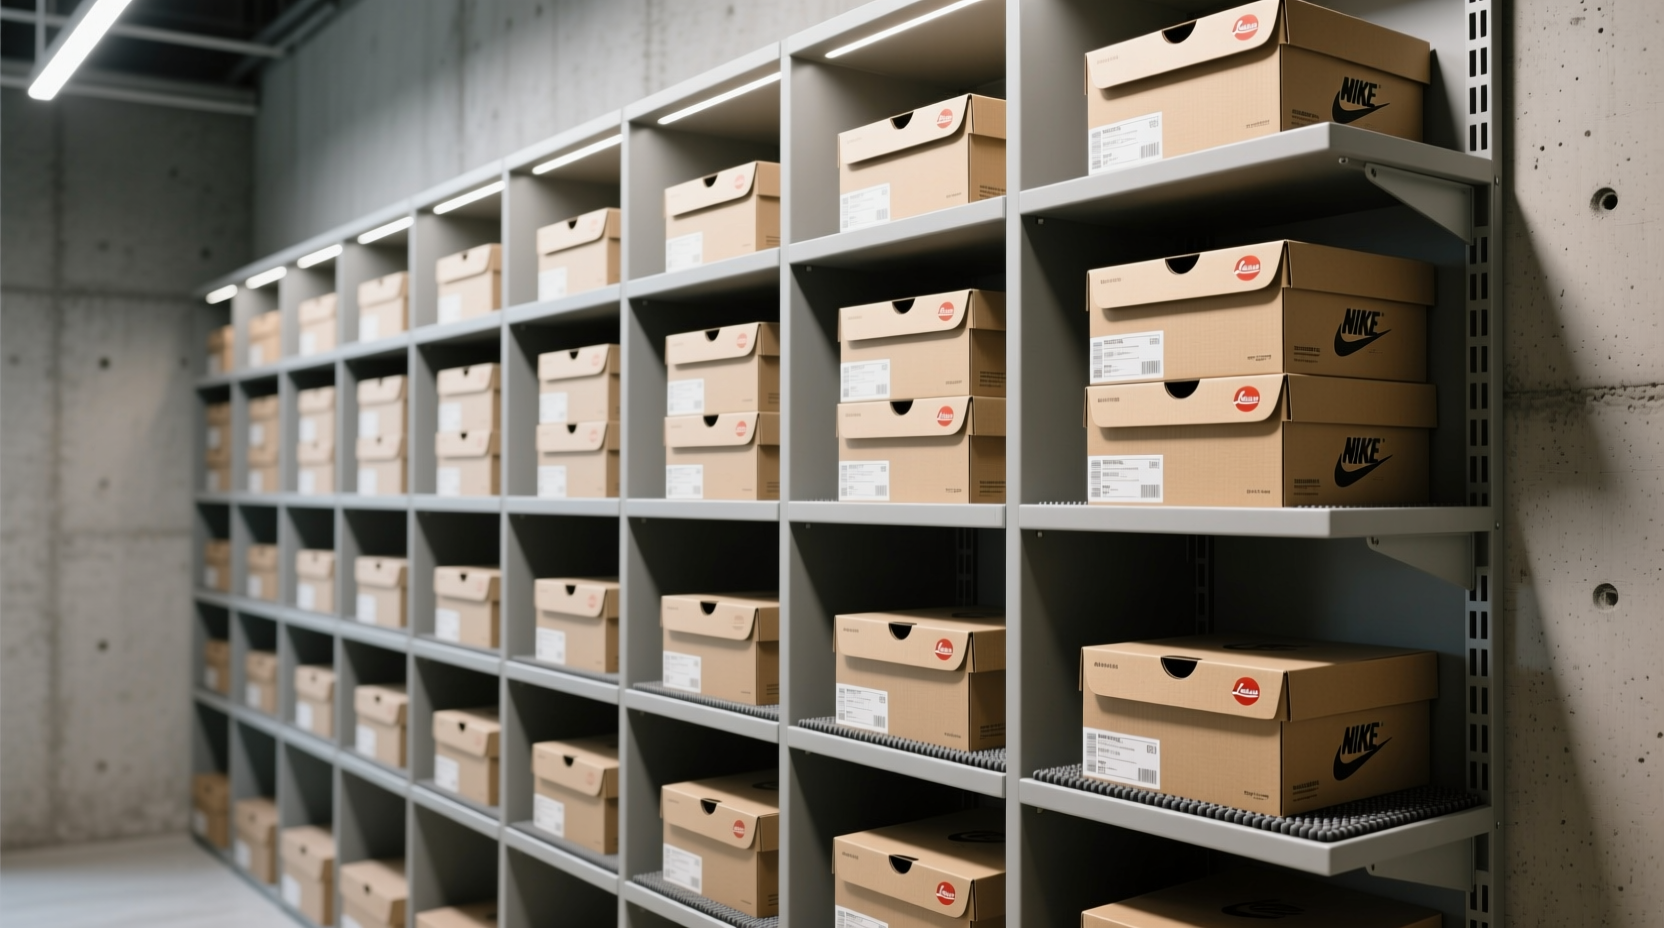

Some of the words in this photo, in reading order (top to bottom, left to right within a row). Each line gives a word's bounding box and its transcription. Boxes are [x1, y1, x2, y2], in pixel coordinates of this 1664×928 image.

[1340, 76, 1378, 108] NIKE
[1341, 307, 1381, 336] NIKE
[1342, 436, 1381, 465] NIKE
[1341, 721, 1380, 755] NIKE
